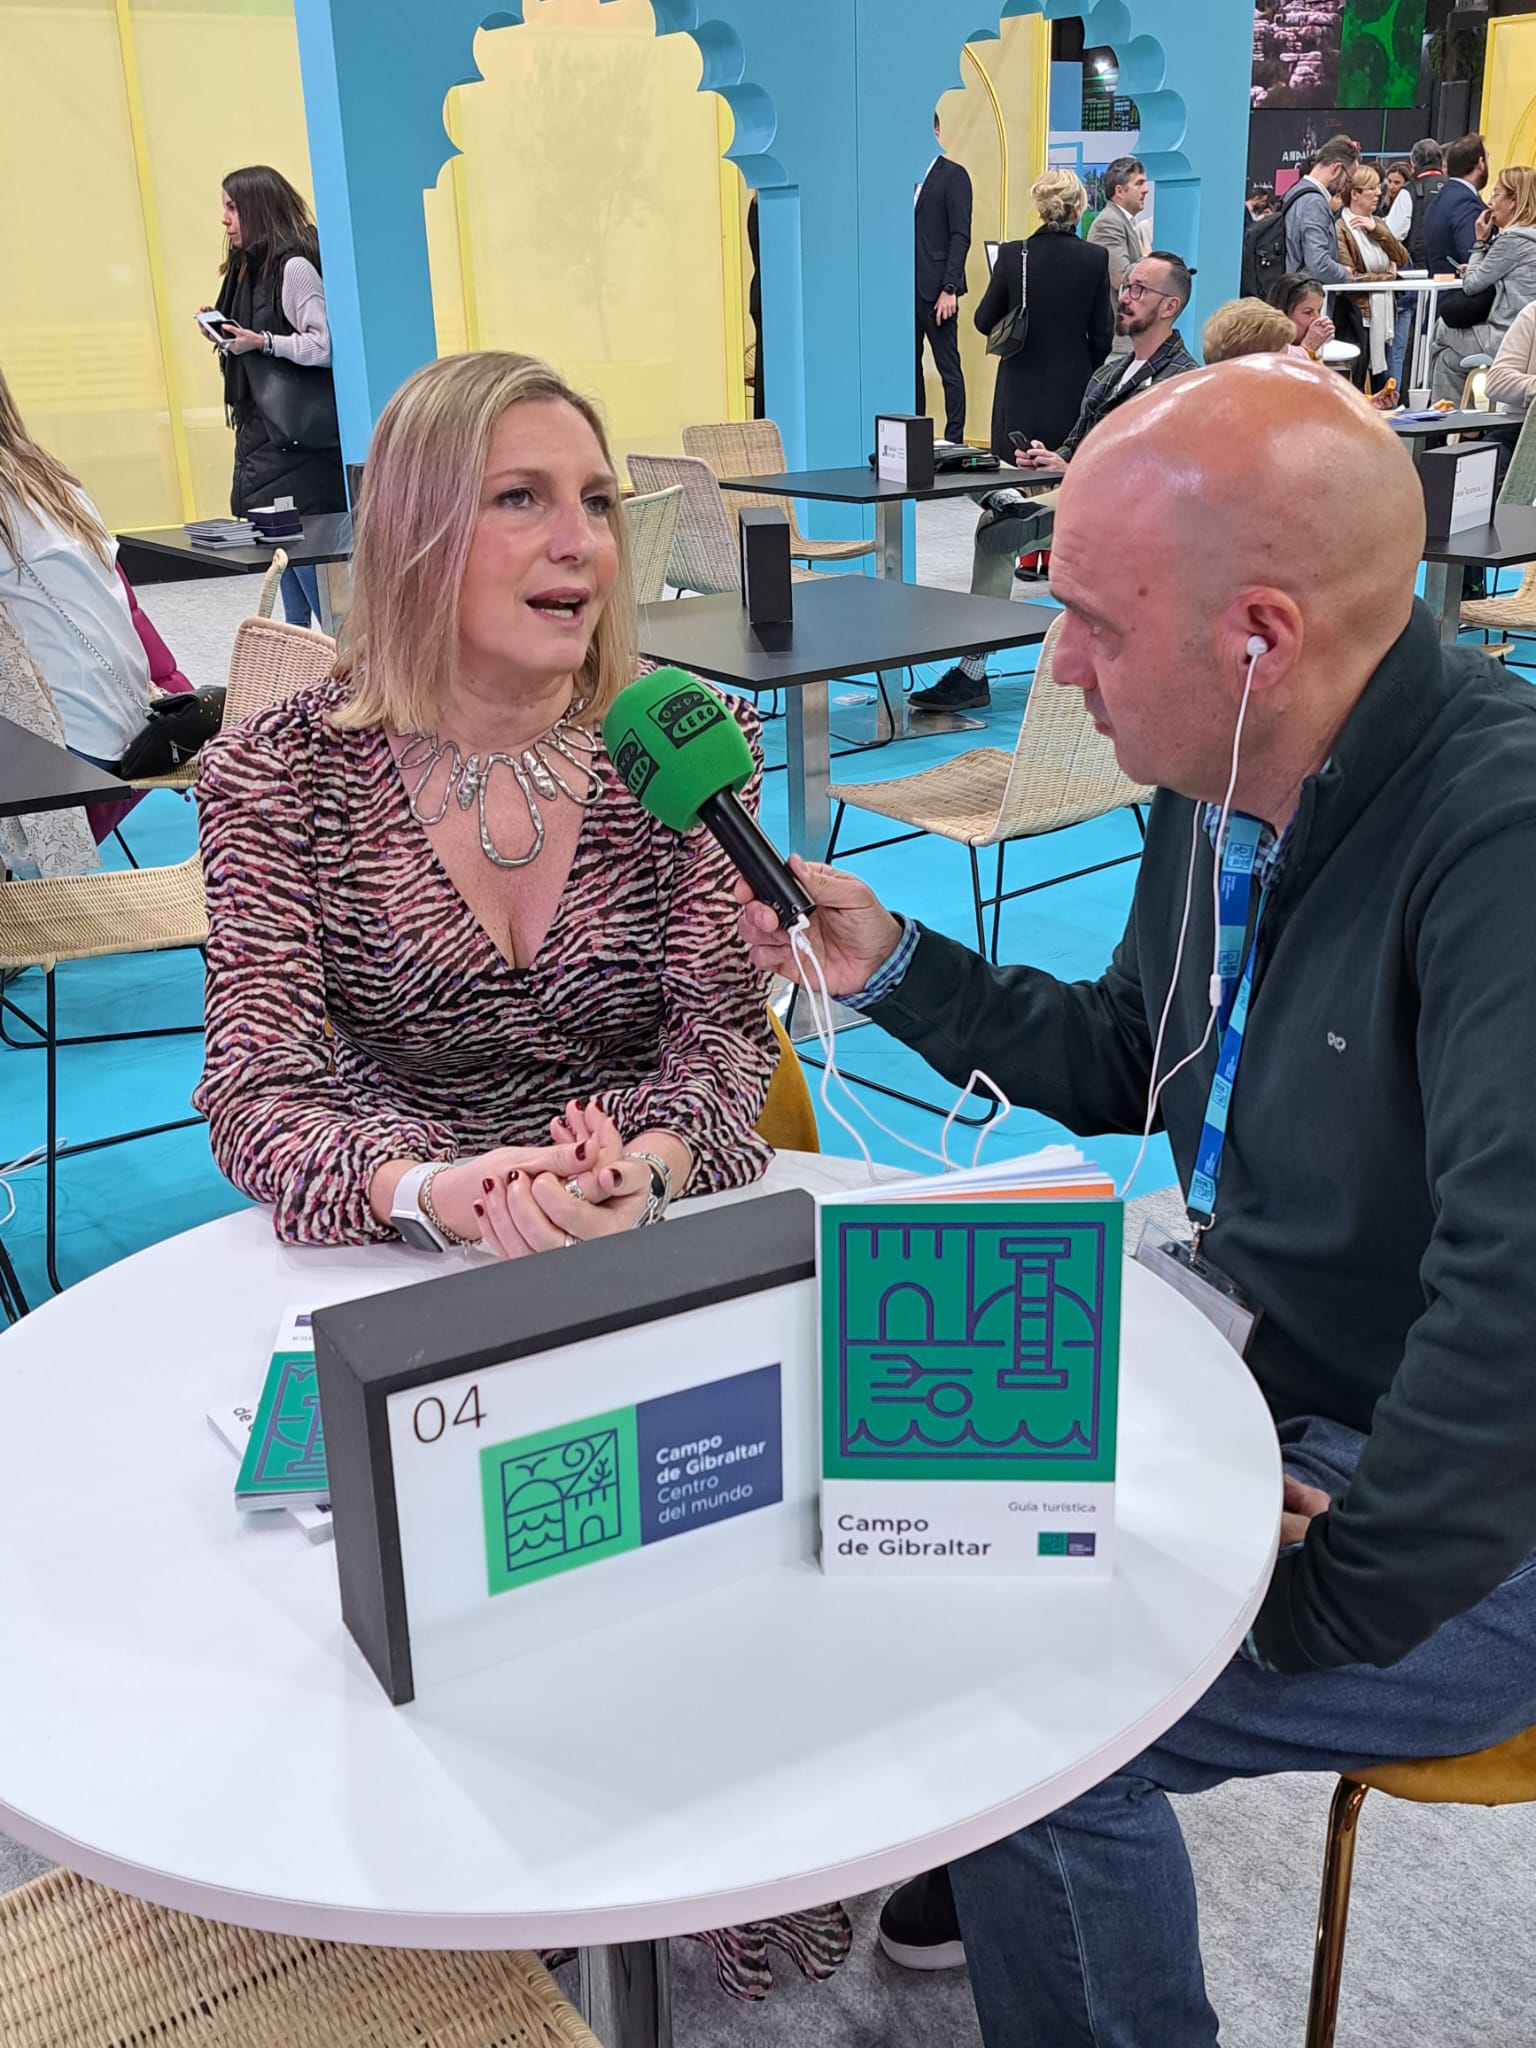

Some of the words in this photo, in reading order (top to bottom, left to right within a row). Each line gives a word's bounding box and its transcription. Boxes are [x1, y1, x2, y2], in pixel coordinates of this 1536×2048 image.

[662, 694, 702, 719] ONDA
[677, 706, 715, 733] CERO
[413, 1384, 487, 1444] 04
[656, 1435, 723, 1464] Campo
[656, 1467, 681, 1485] de
[685, 1441, 766, 1475] Gibraltar
[657, 1475, 719, 1504] Centro
[658, 1502, 686, 1524] del
[691, 1484, 753, 1514] mundo
[1007, 1501, 1039, 1513] Guía
[1042, 1501, 1097, 1513] turística
[837, 1514, 929, 1536] Campo
[837, 1539, 869, 1556] de
[878, 1538, 992, 1556] Gibraltar
